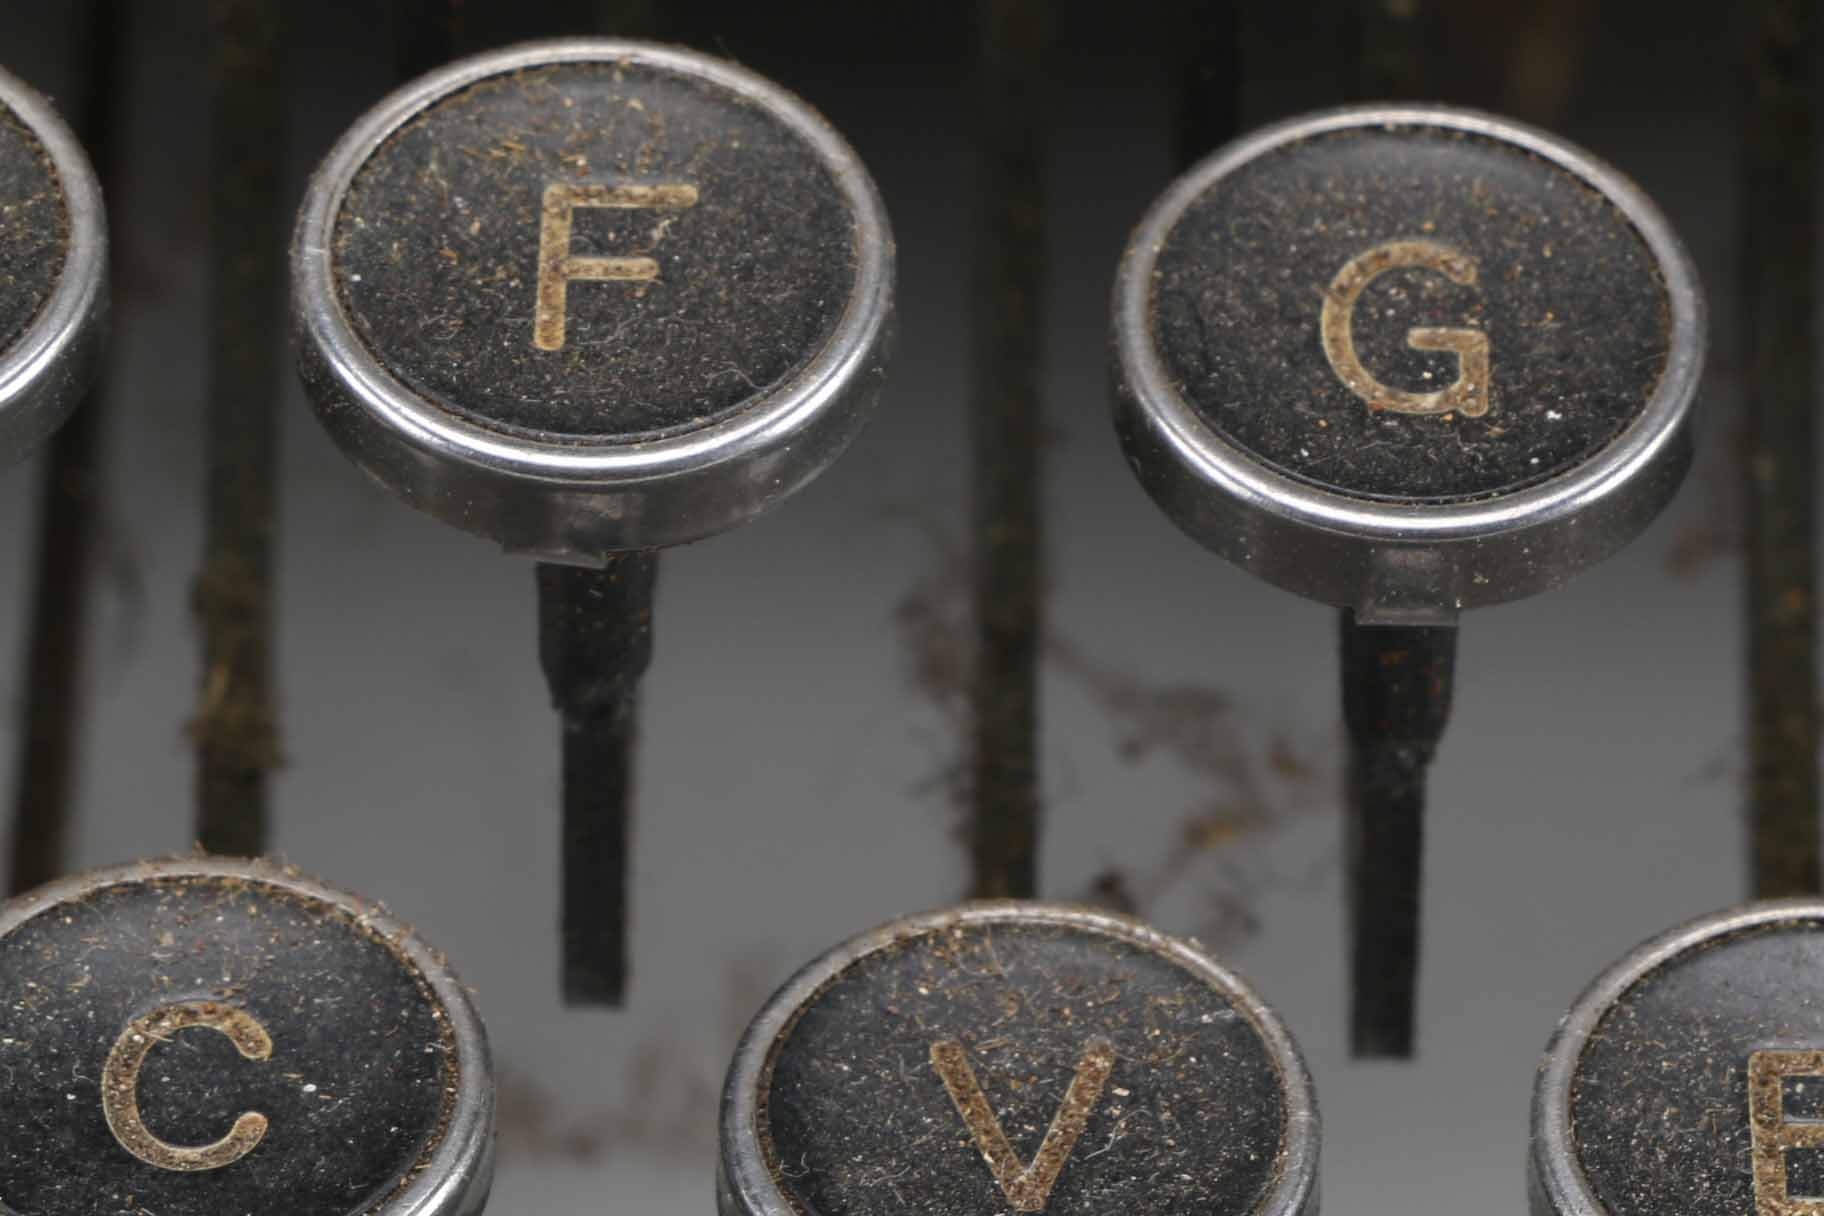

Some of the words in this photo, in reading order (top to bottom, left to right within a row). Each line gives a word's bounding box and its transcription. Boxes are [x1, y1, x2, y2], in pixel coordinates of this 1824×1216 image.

[533, 181, 698, 350] F
[1320, 238, 1489, 417] G
[100, 1003, 272, 1171] C
[930, 1040, 1116, 1211] V
